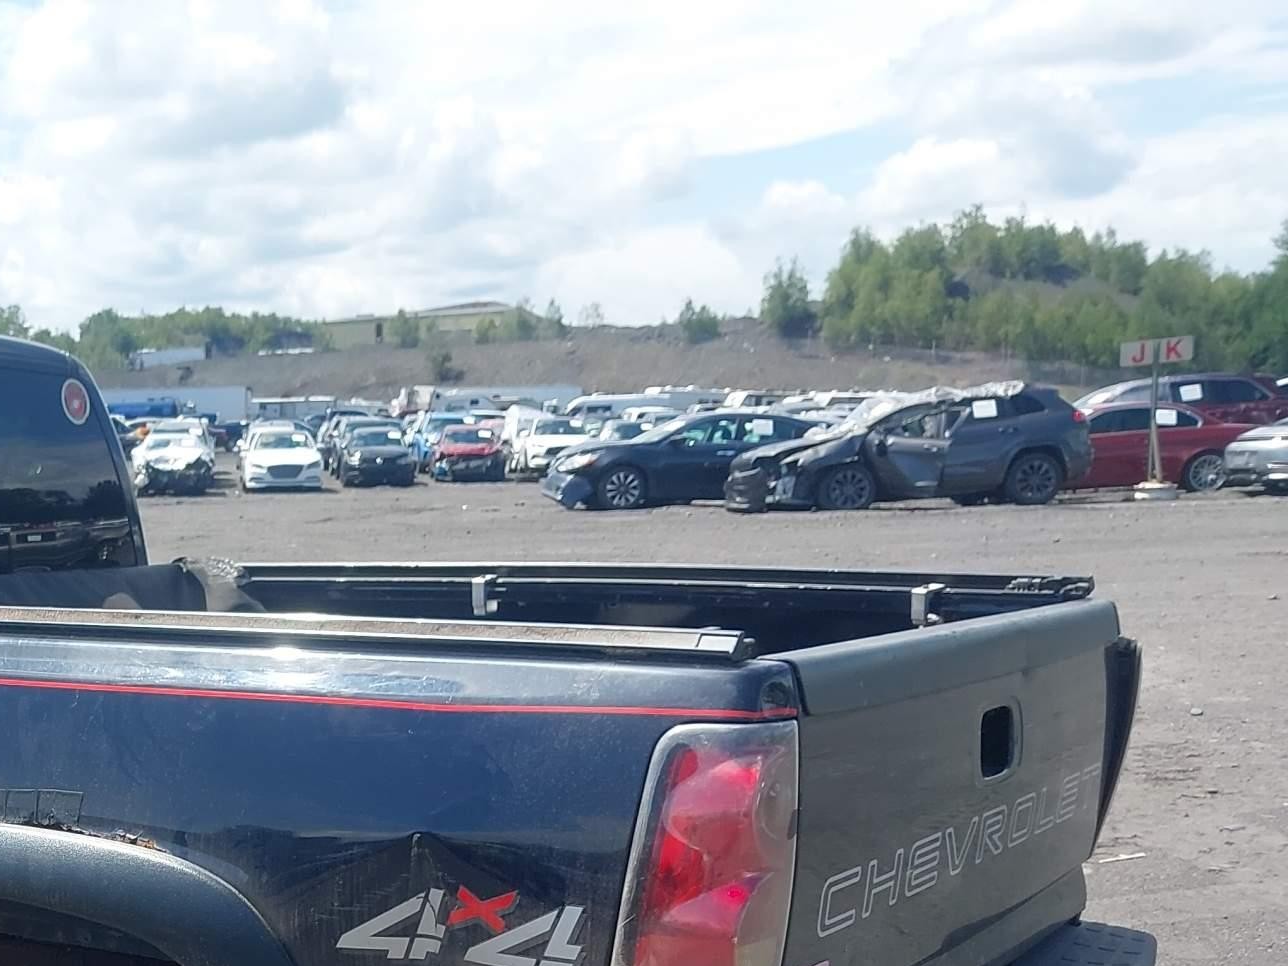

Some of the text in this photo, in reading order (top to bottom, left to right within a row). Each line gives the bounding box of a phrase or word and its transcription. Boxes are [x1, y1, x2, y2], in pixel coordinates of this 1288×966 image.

[1132, 338, 1184, 363] J K
[817, 763, 1102, 938] CHEVROLET
